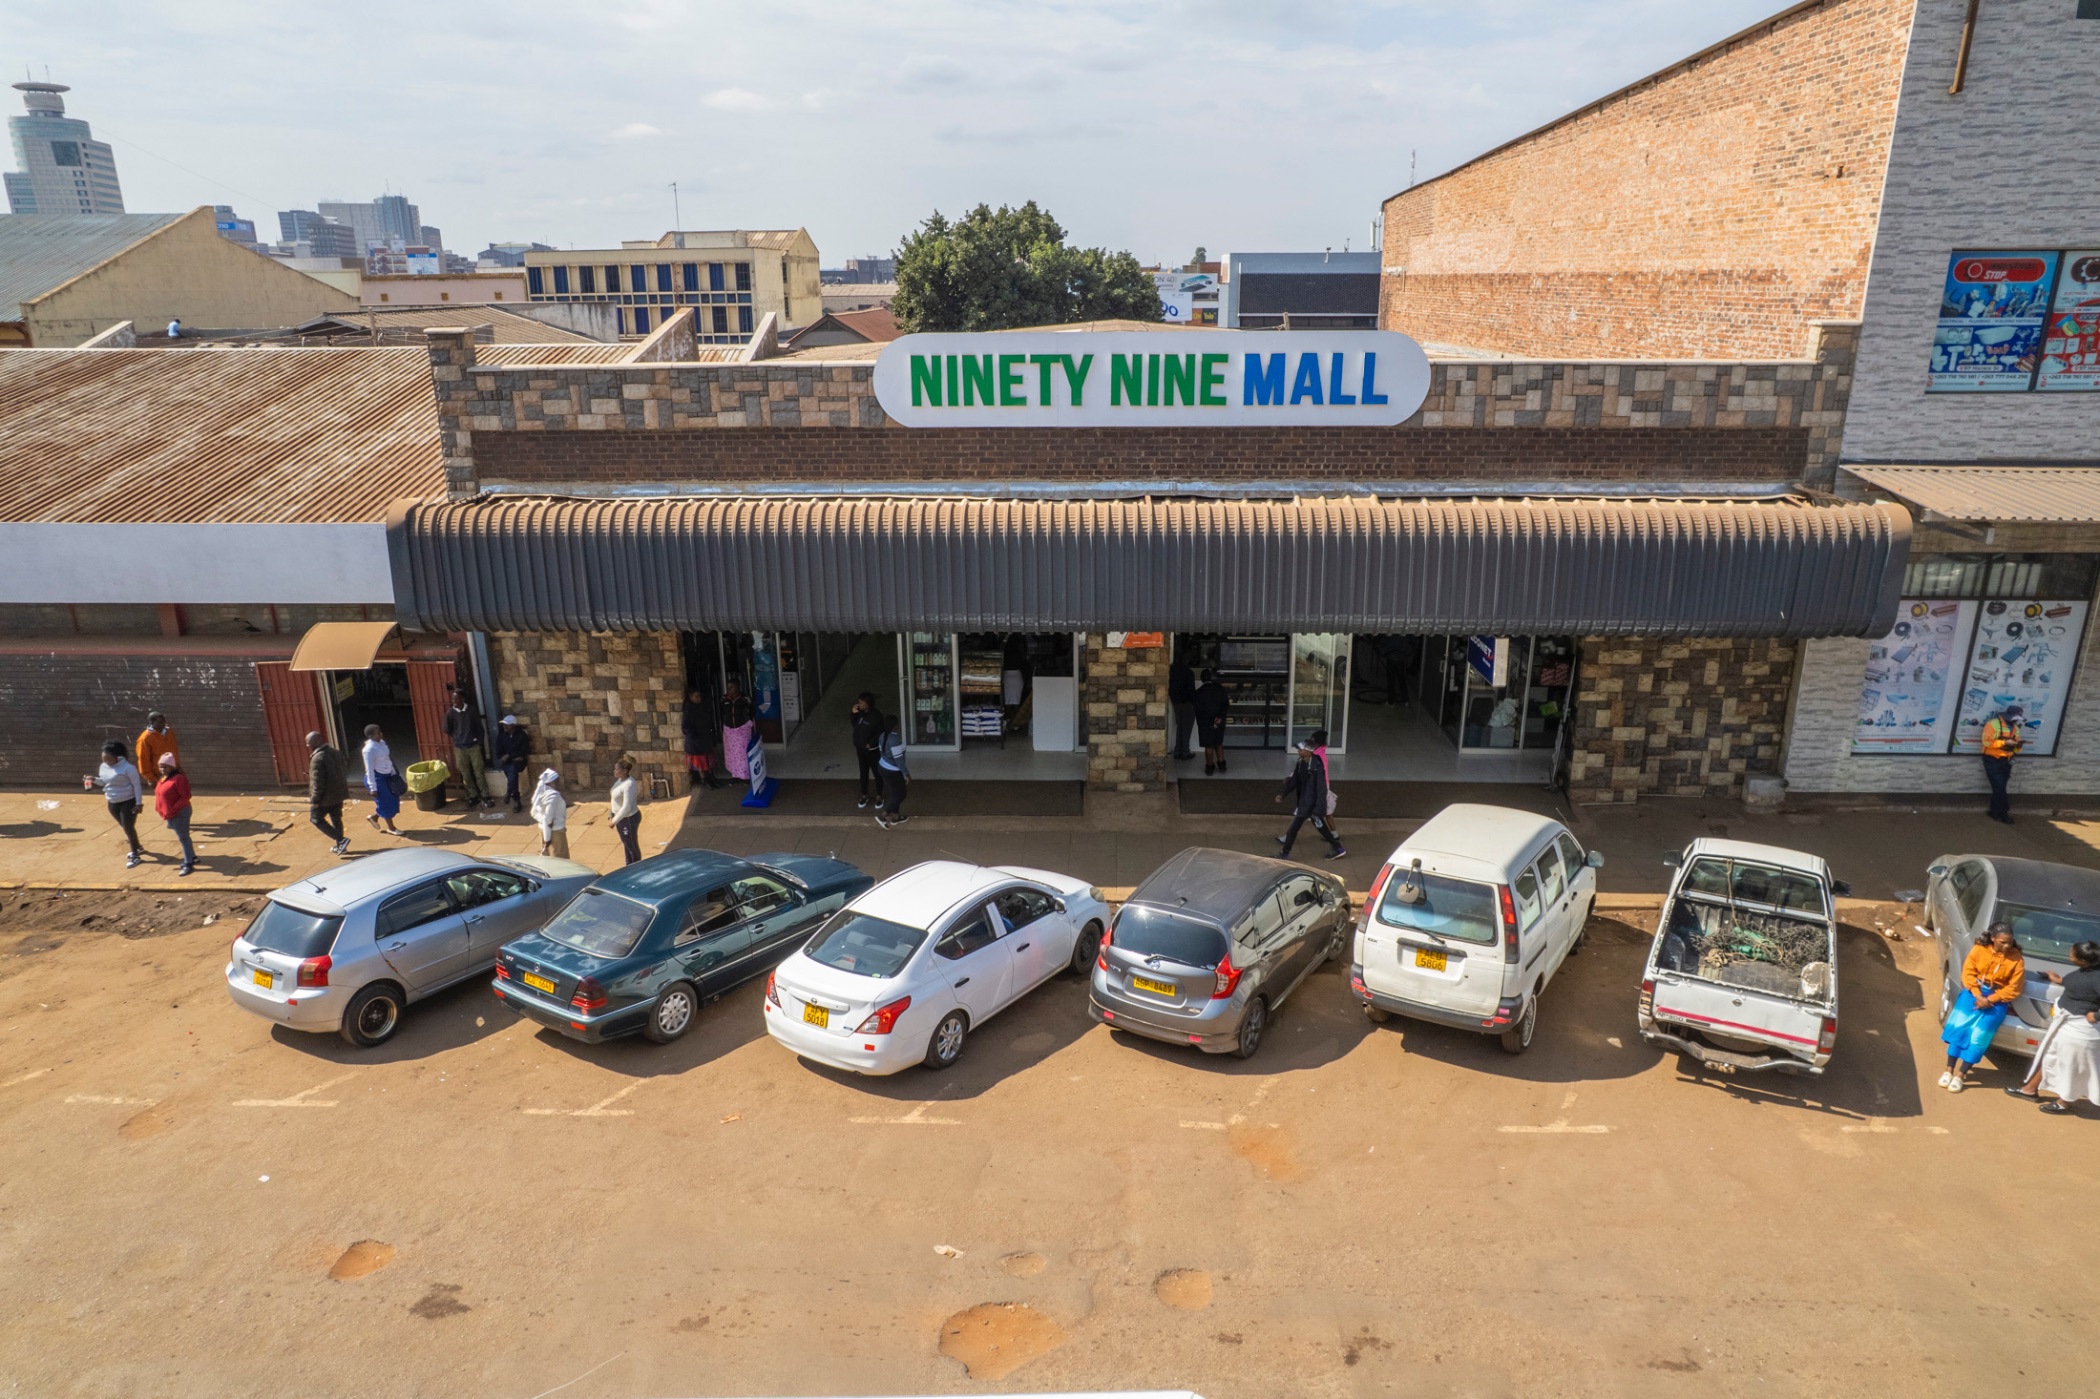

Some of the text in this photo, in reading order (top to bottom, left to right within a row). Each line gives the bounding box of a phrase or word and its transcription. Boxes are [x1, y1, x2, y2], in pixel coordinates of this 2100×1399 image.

[1984, 270, 2007, 279] STOP
[909, 352, 1389, 407] NINETY NINE MALL
[1420, 957, 1443, 970] 5806
[806, 1012, 825, 1027] 5018
